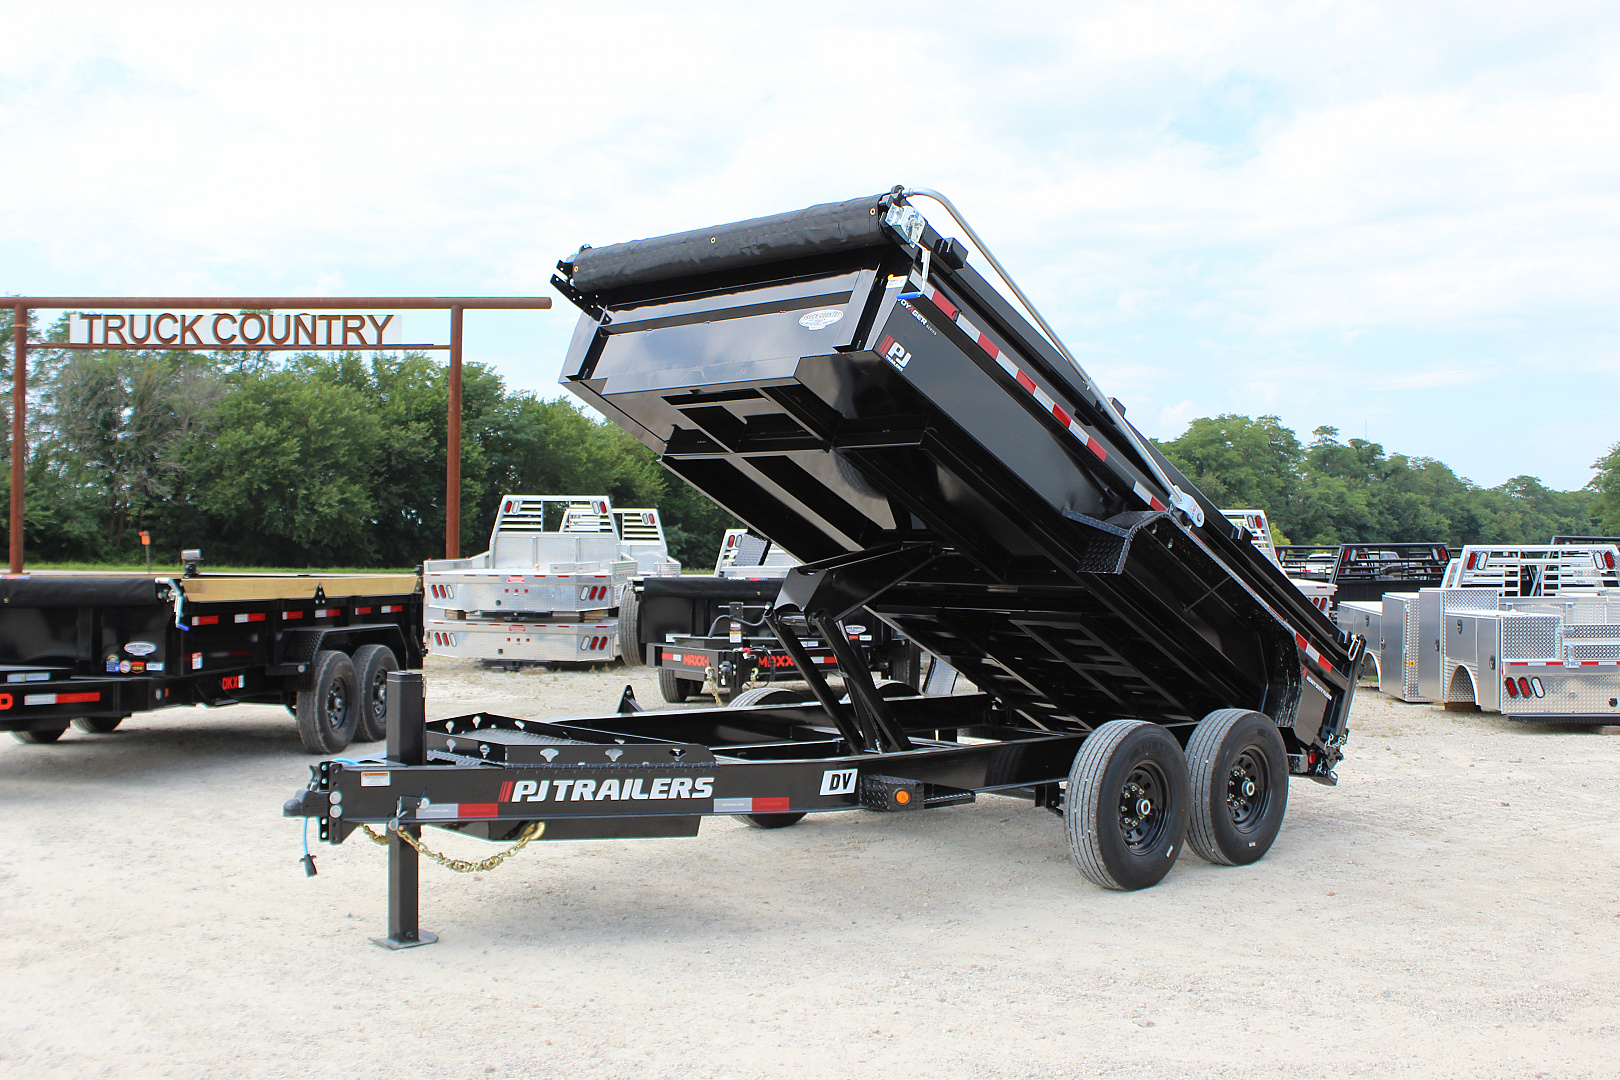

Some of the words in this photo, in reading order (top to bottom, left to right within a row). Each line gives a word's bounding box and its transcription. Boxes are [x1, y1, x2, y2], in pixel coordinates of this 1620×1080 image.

[897, 298, 928, 325] OYAGER
[80, 312, 204, 345] TRUCK
[211, 312, 394, 345] COUNTRY
[887, 341, 912, 368] PJ
[511, 779, 550, 803] PJ
[552, 777, 715, 801] TRAILERS
[828, 772, 852, 791] DV
